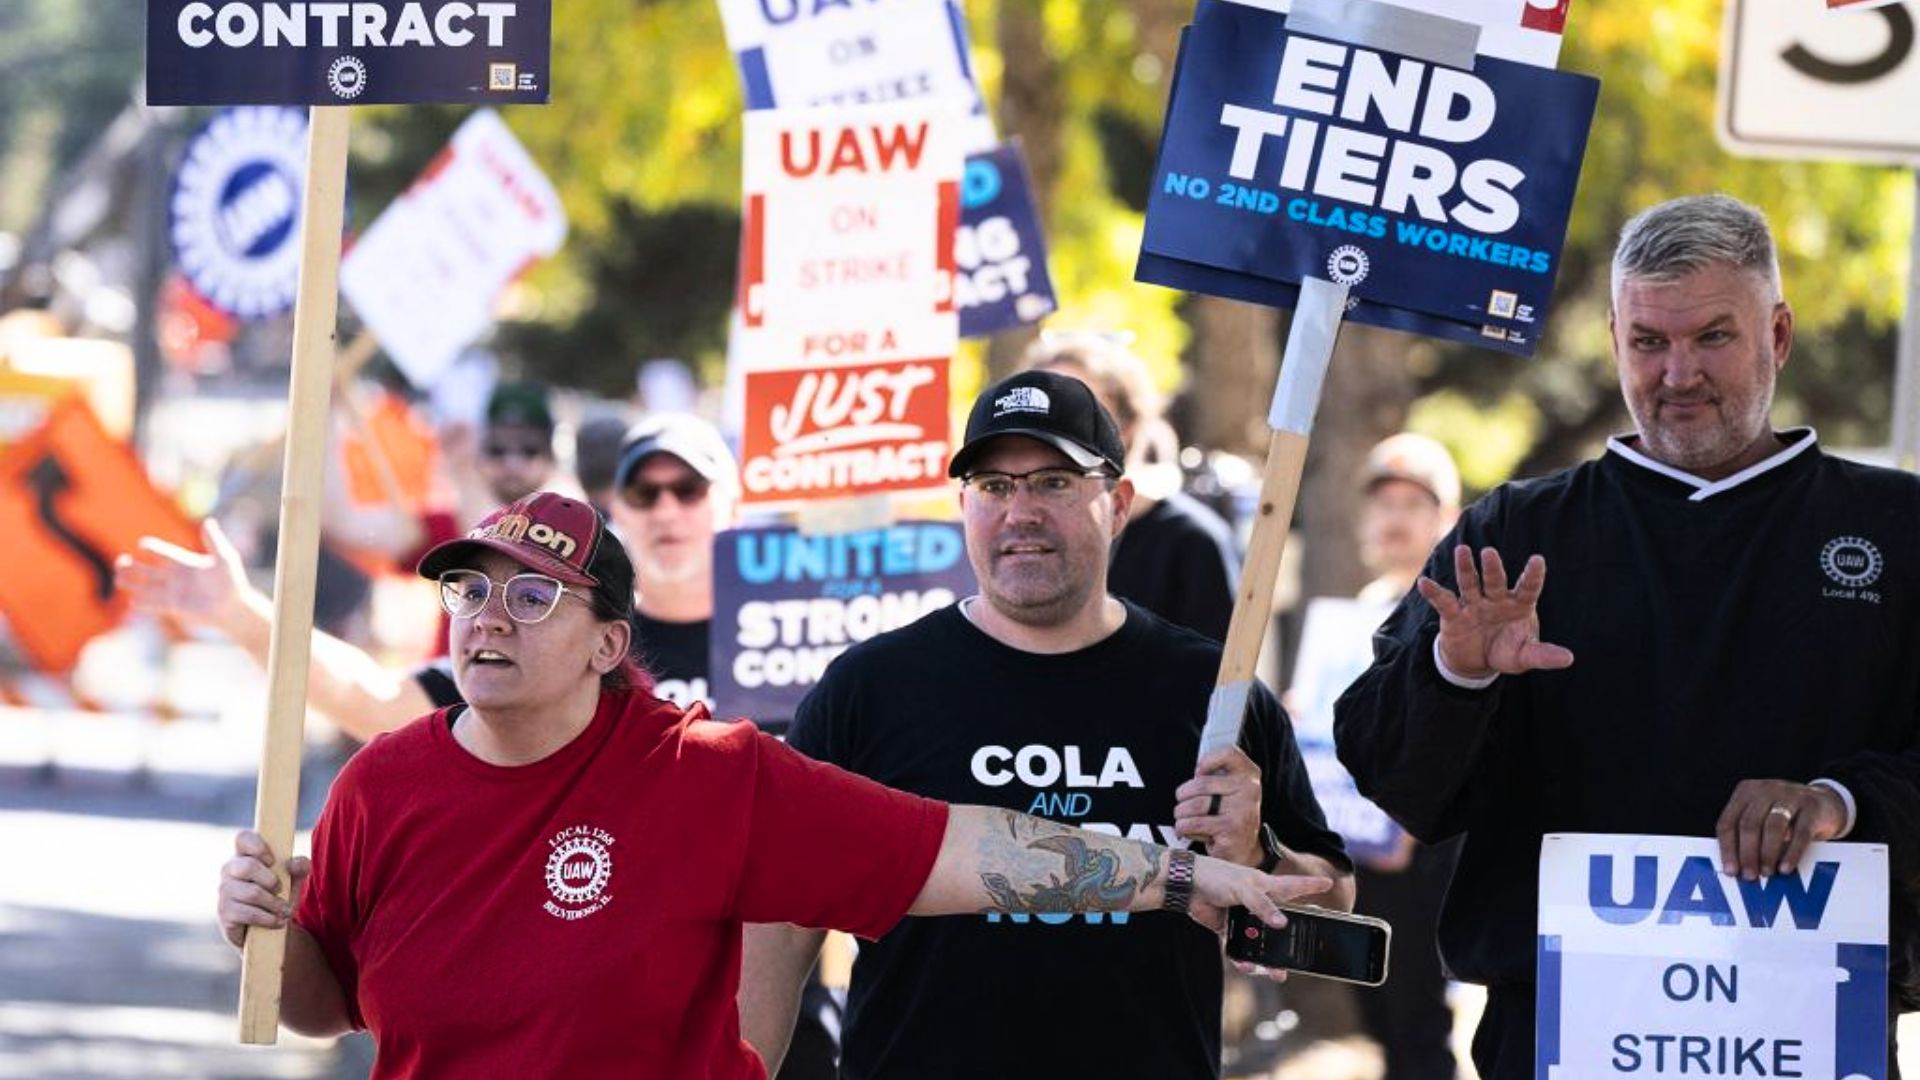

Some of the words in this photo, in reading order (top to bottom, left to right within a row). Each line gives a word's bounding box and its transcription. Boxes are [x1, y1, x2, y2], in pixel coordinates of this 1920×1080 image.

[177, 2, 516, 48] CONTRACT
[1272, 36, 1497, 143] END
[780, 122, 928, 178] UAW
[1220, 104, 1526, 233] TIERS
[831, 206, 876, 233] ON
[1164, 172, 1209, 201] NO
[1217, 184, 1279, 215] 2ND
[1288, 199, 1387, 239] CLASS
[1397, 222, 1550, 274] WORKERS
[800, 253, 914, 289] STRIKE
[804, 331, 867, 355] FOR
[881, 330, 896, 349] A
[770, 364, 935, 445] JUST
[744, 442, 948, 492] CONTRACT
[736, 524, 964, 583] UNITED
[1837, 554, 1865, 567] UAW
[1822, 586, 1855, 599] Local
[970, 744, 1145, 788] COLA
[1027, 792, 1092, 816] AND
[548, 825, 590, 847] LOCAL
[563, 861, 596, 879] UAW
[1588, 854, 1840, 930] UAW
[1662, 963, 1738, 1003] ON
[1611, 1034, 1803, 1078] STRIKE
